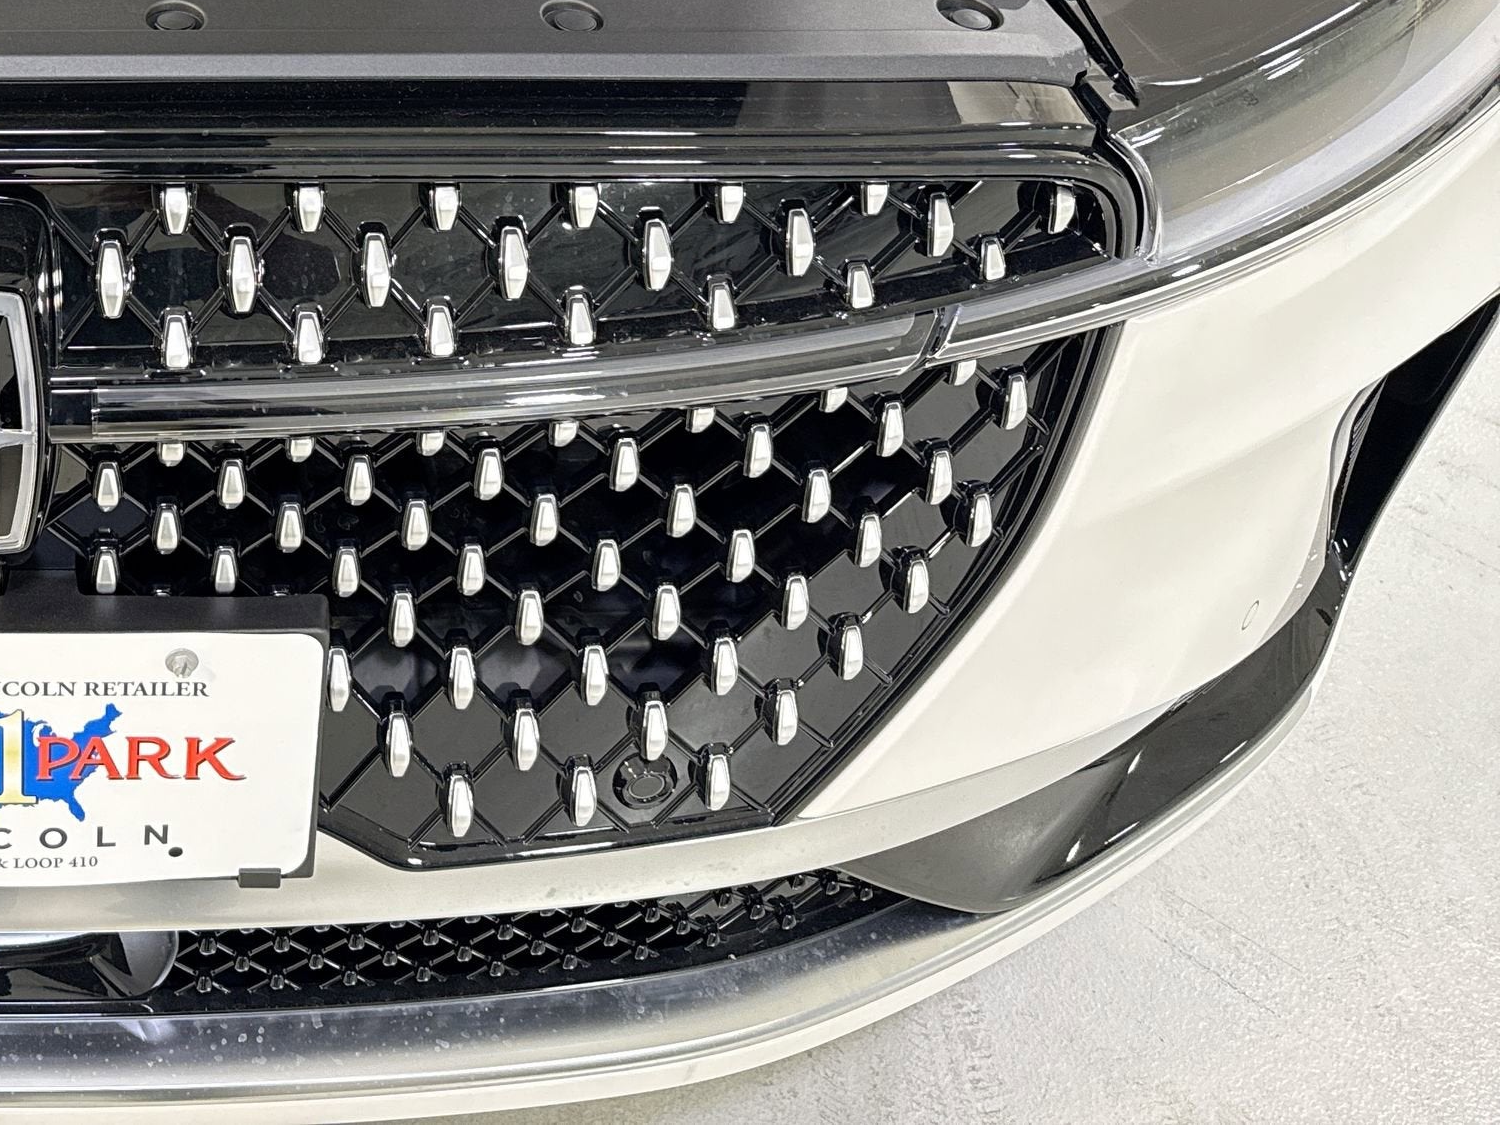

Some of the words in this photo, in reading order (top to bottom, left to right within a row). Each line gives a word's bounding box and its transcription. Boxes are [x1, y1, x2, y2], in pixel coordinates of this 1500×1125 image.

[83, 681, 210, 697] RETAILER
[36, 735, 247, 781] PARK
[13, 856, 64, 869] LOOP
[68, 855, 99, 868] 410
